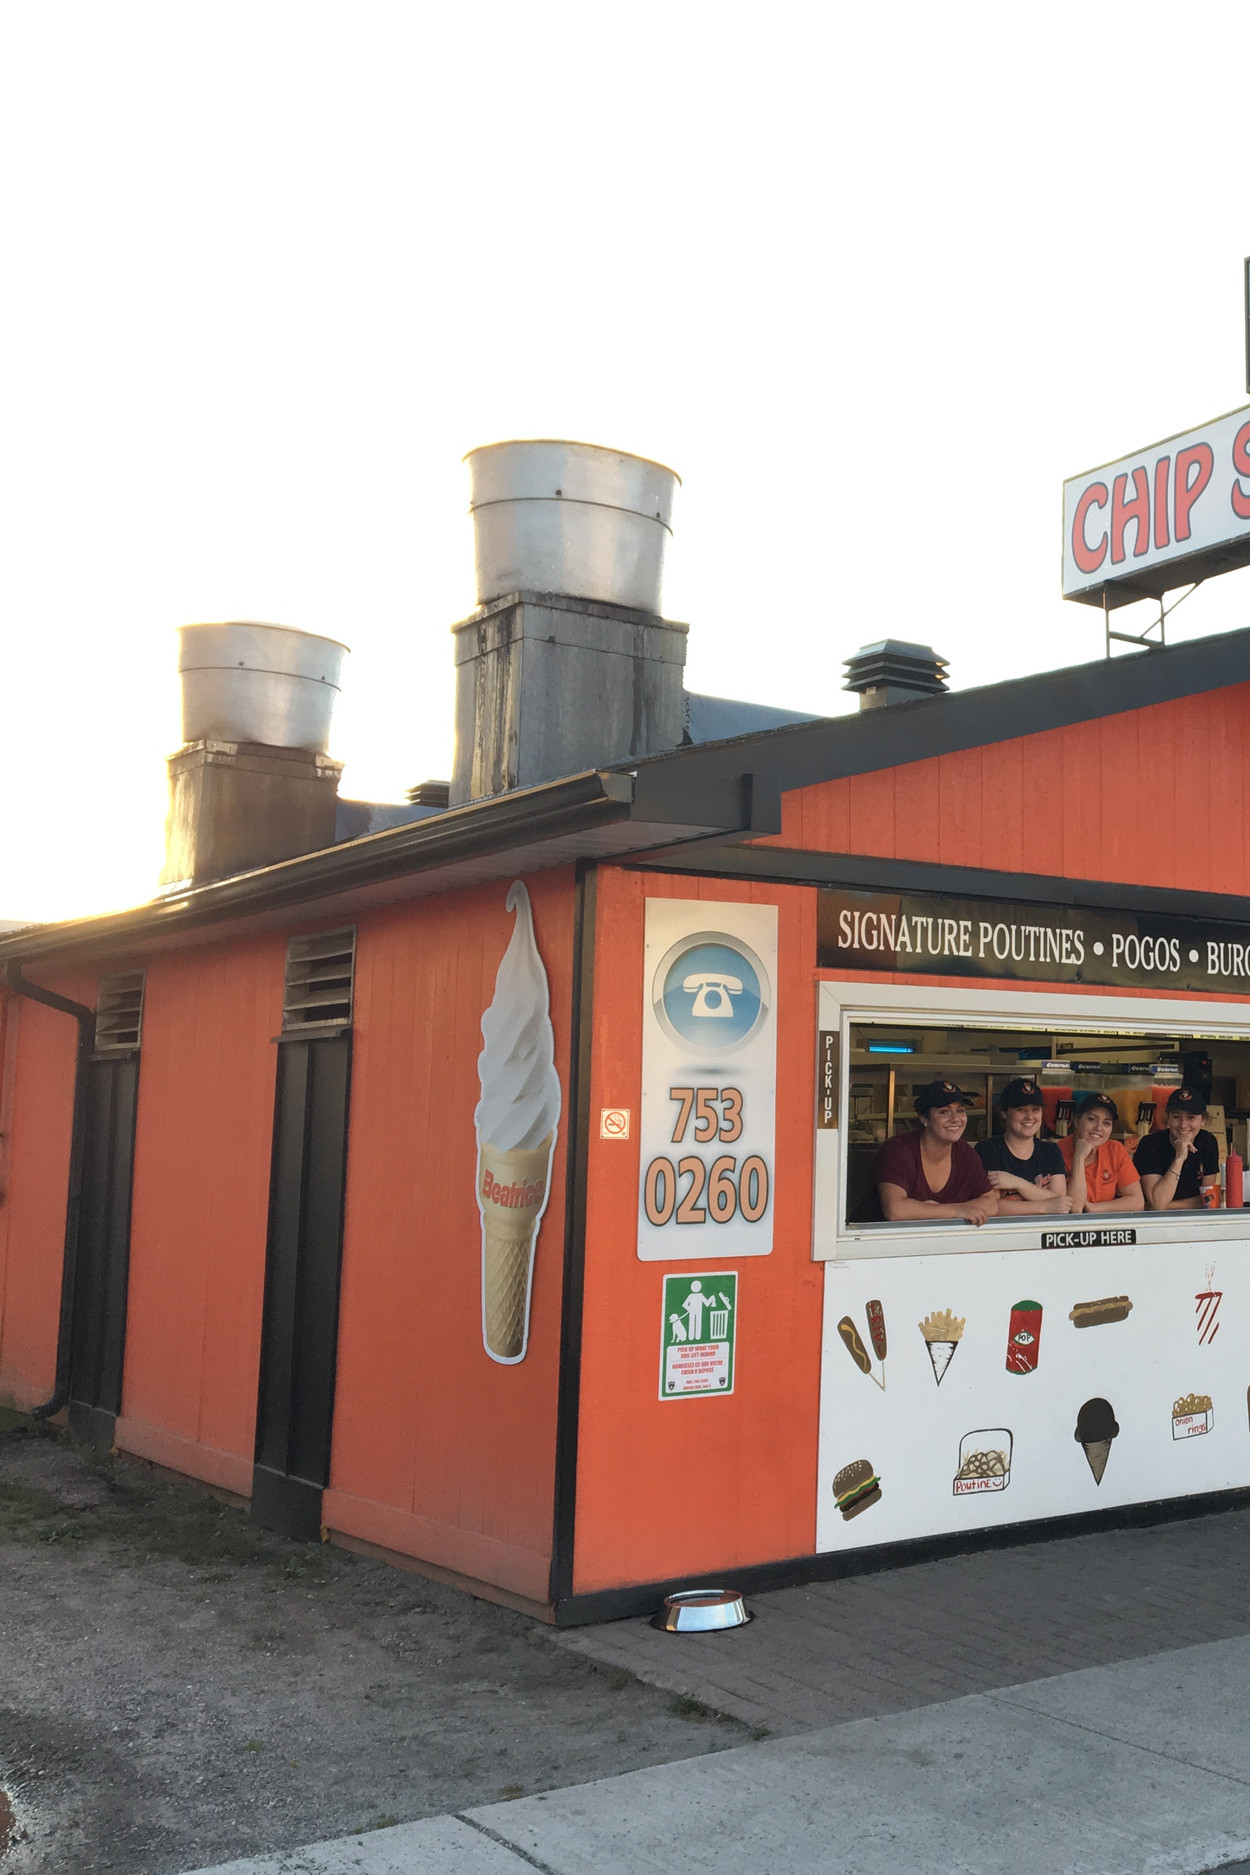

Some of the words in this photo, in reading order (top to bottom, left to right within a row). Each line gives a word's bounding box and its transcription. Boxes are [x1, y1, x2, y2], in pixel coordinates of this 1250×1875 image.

[1071, 442, 1214, 574] CHIP
[838, 909, 972, 957] SIGNATURE
[978, 921, 1085, 965] POUTINES
[1112, 933, 1181, 972] POGOS
[824, 1035, 833, 1124] PICK-UP
[670, 1087, 743, 1143] 753
[482, 1168, 544, 1208] Beatrice
[644, 1154, 769, 1227] 0260
[1046, 1232, 1097, 1247] PICK-UP
[1101, 1230, 1132, 1244] HERE
[1018, 1333, 1031, 1342] POP
[1175, 1416, 1193, 1426] onion
[1188, 1423, 1207, 1434] rings
